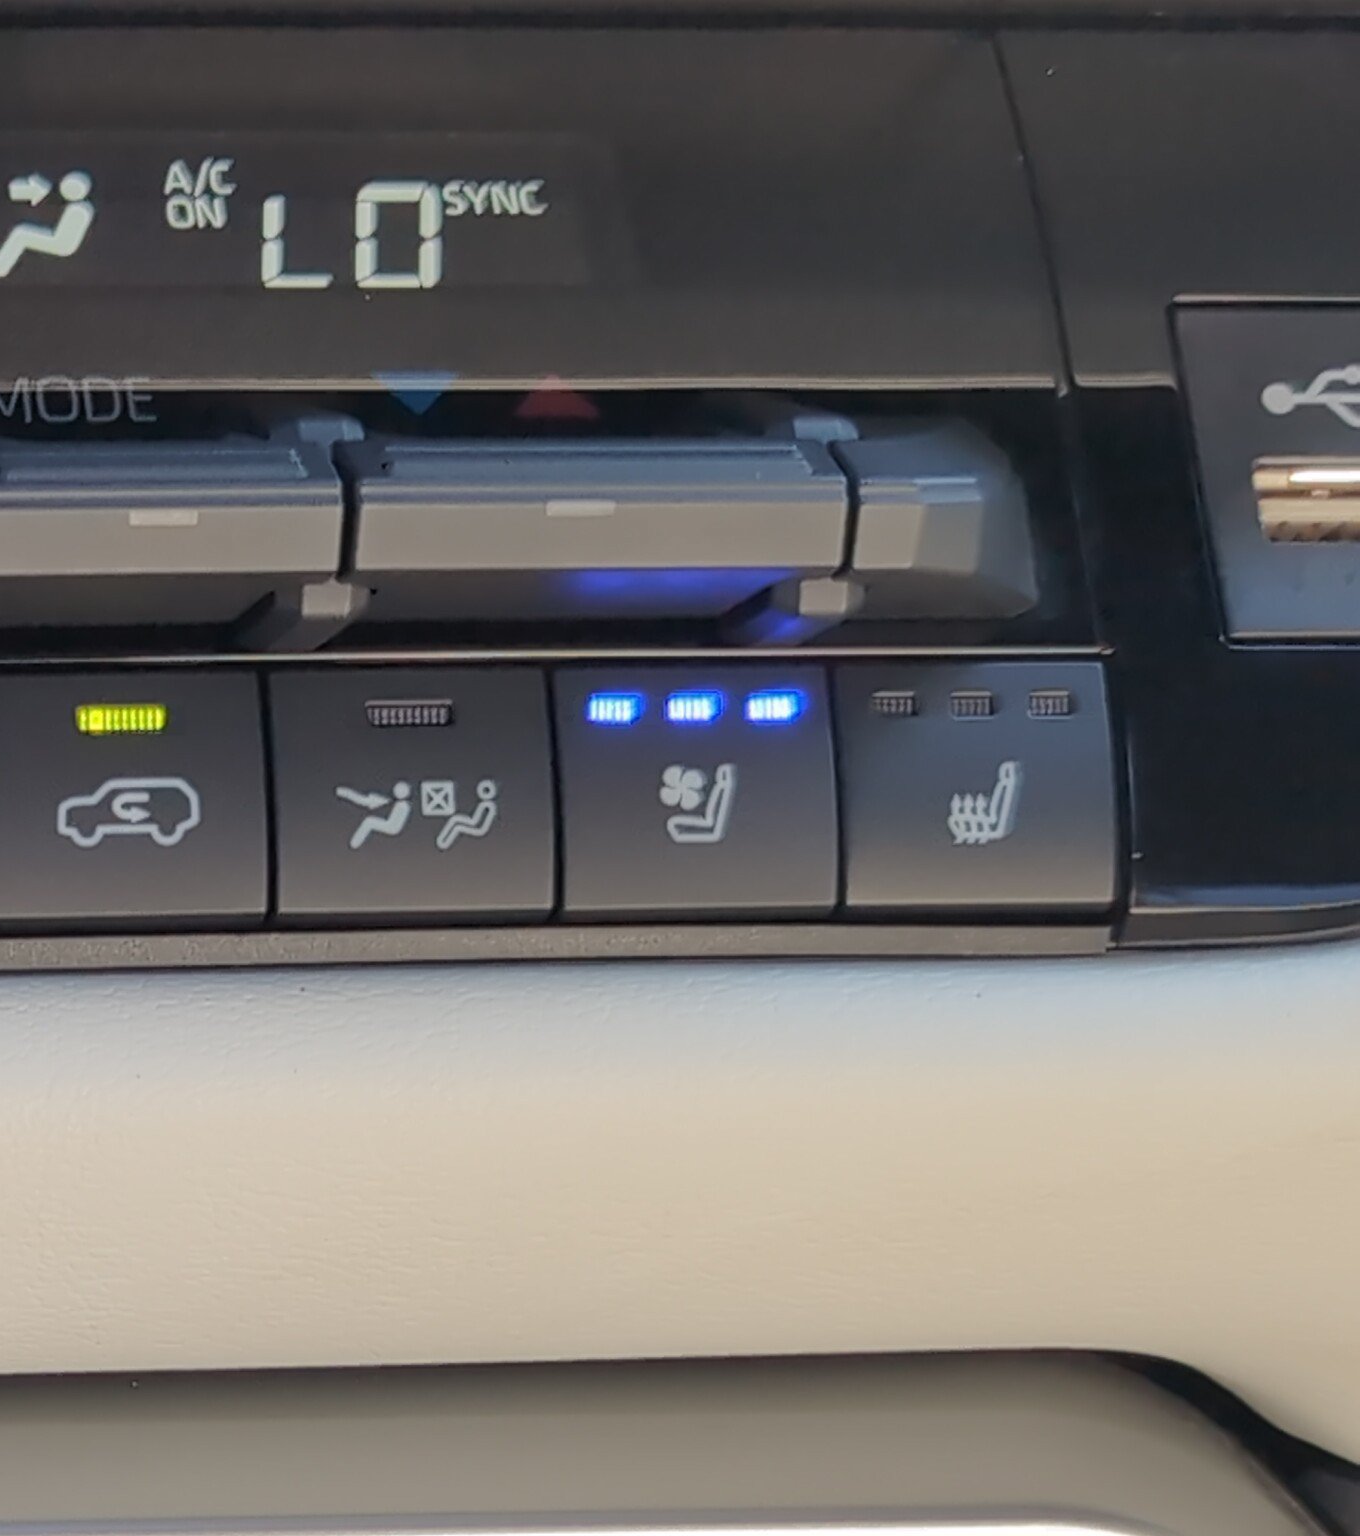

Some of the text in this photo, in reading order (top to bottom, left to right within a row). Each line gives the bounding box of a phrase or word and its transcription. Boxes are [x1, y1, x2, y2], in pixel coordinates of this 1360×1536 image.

[163, 156, 238, 197] A/C
[165, 196, 229, 230] ON
[442, 180, 549, 217] SYNC
